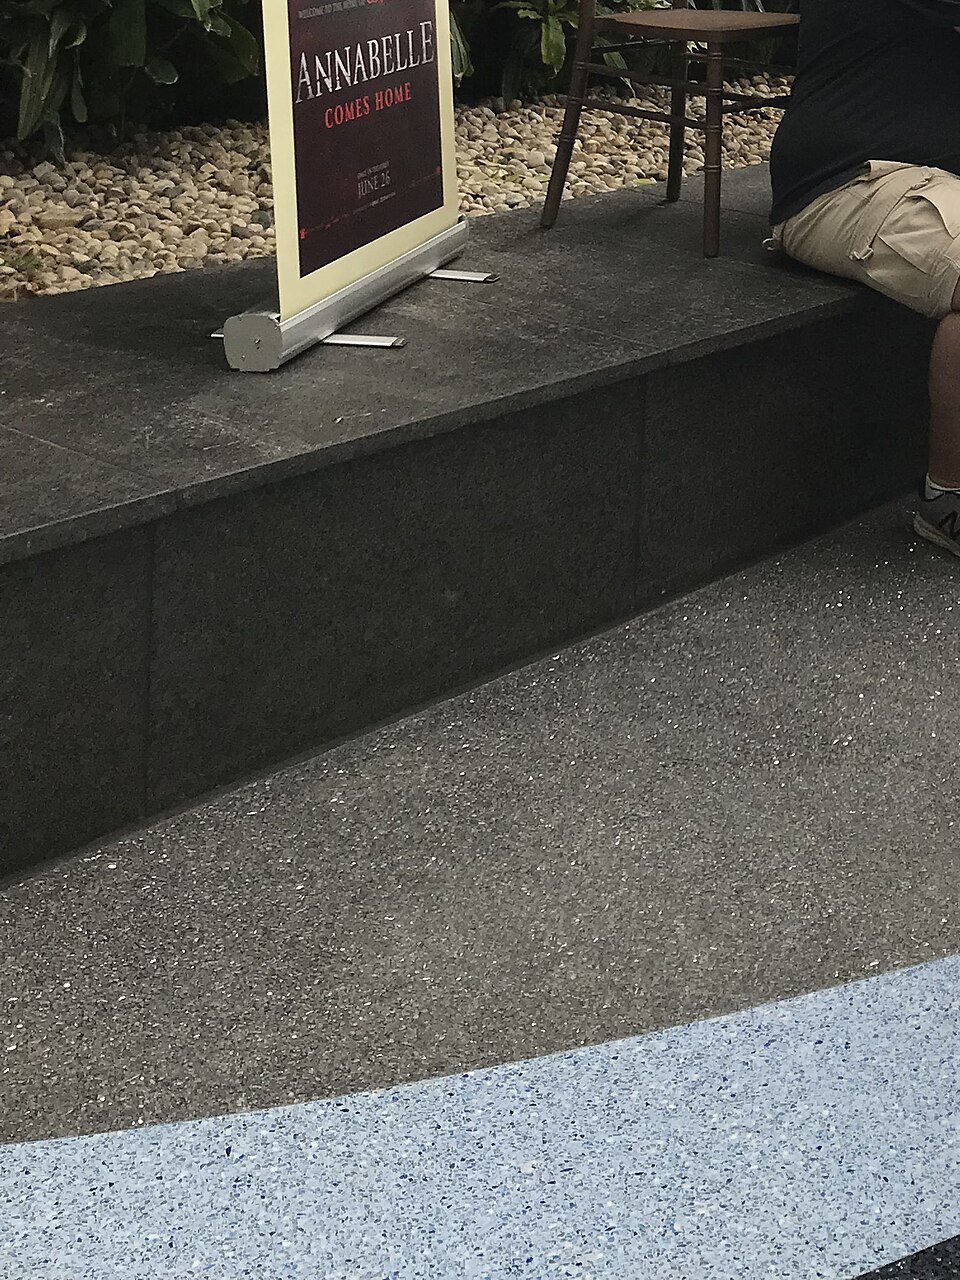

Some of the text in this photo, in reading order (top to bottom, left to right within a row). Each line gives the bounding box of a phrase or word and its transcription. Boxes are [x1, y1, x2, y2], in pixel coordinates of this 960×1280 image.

[296, 20, 434, 104] ANNABELLE
[324, 82, 412, 129] COMES HOME
[358, 171, 391, 199] JUNE 26
